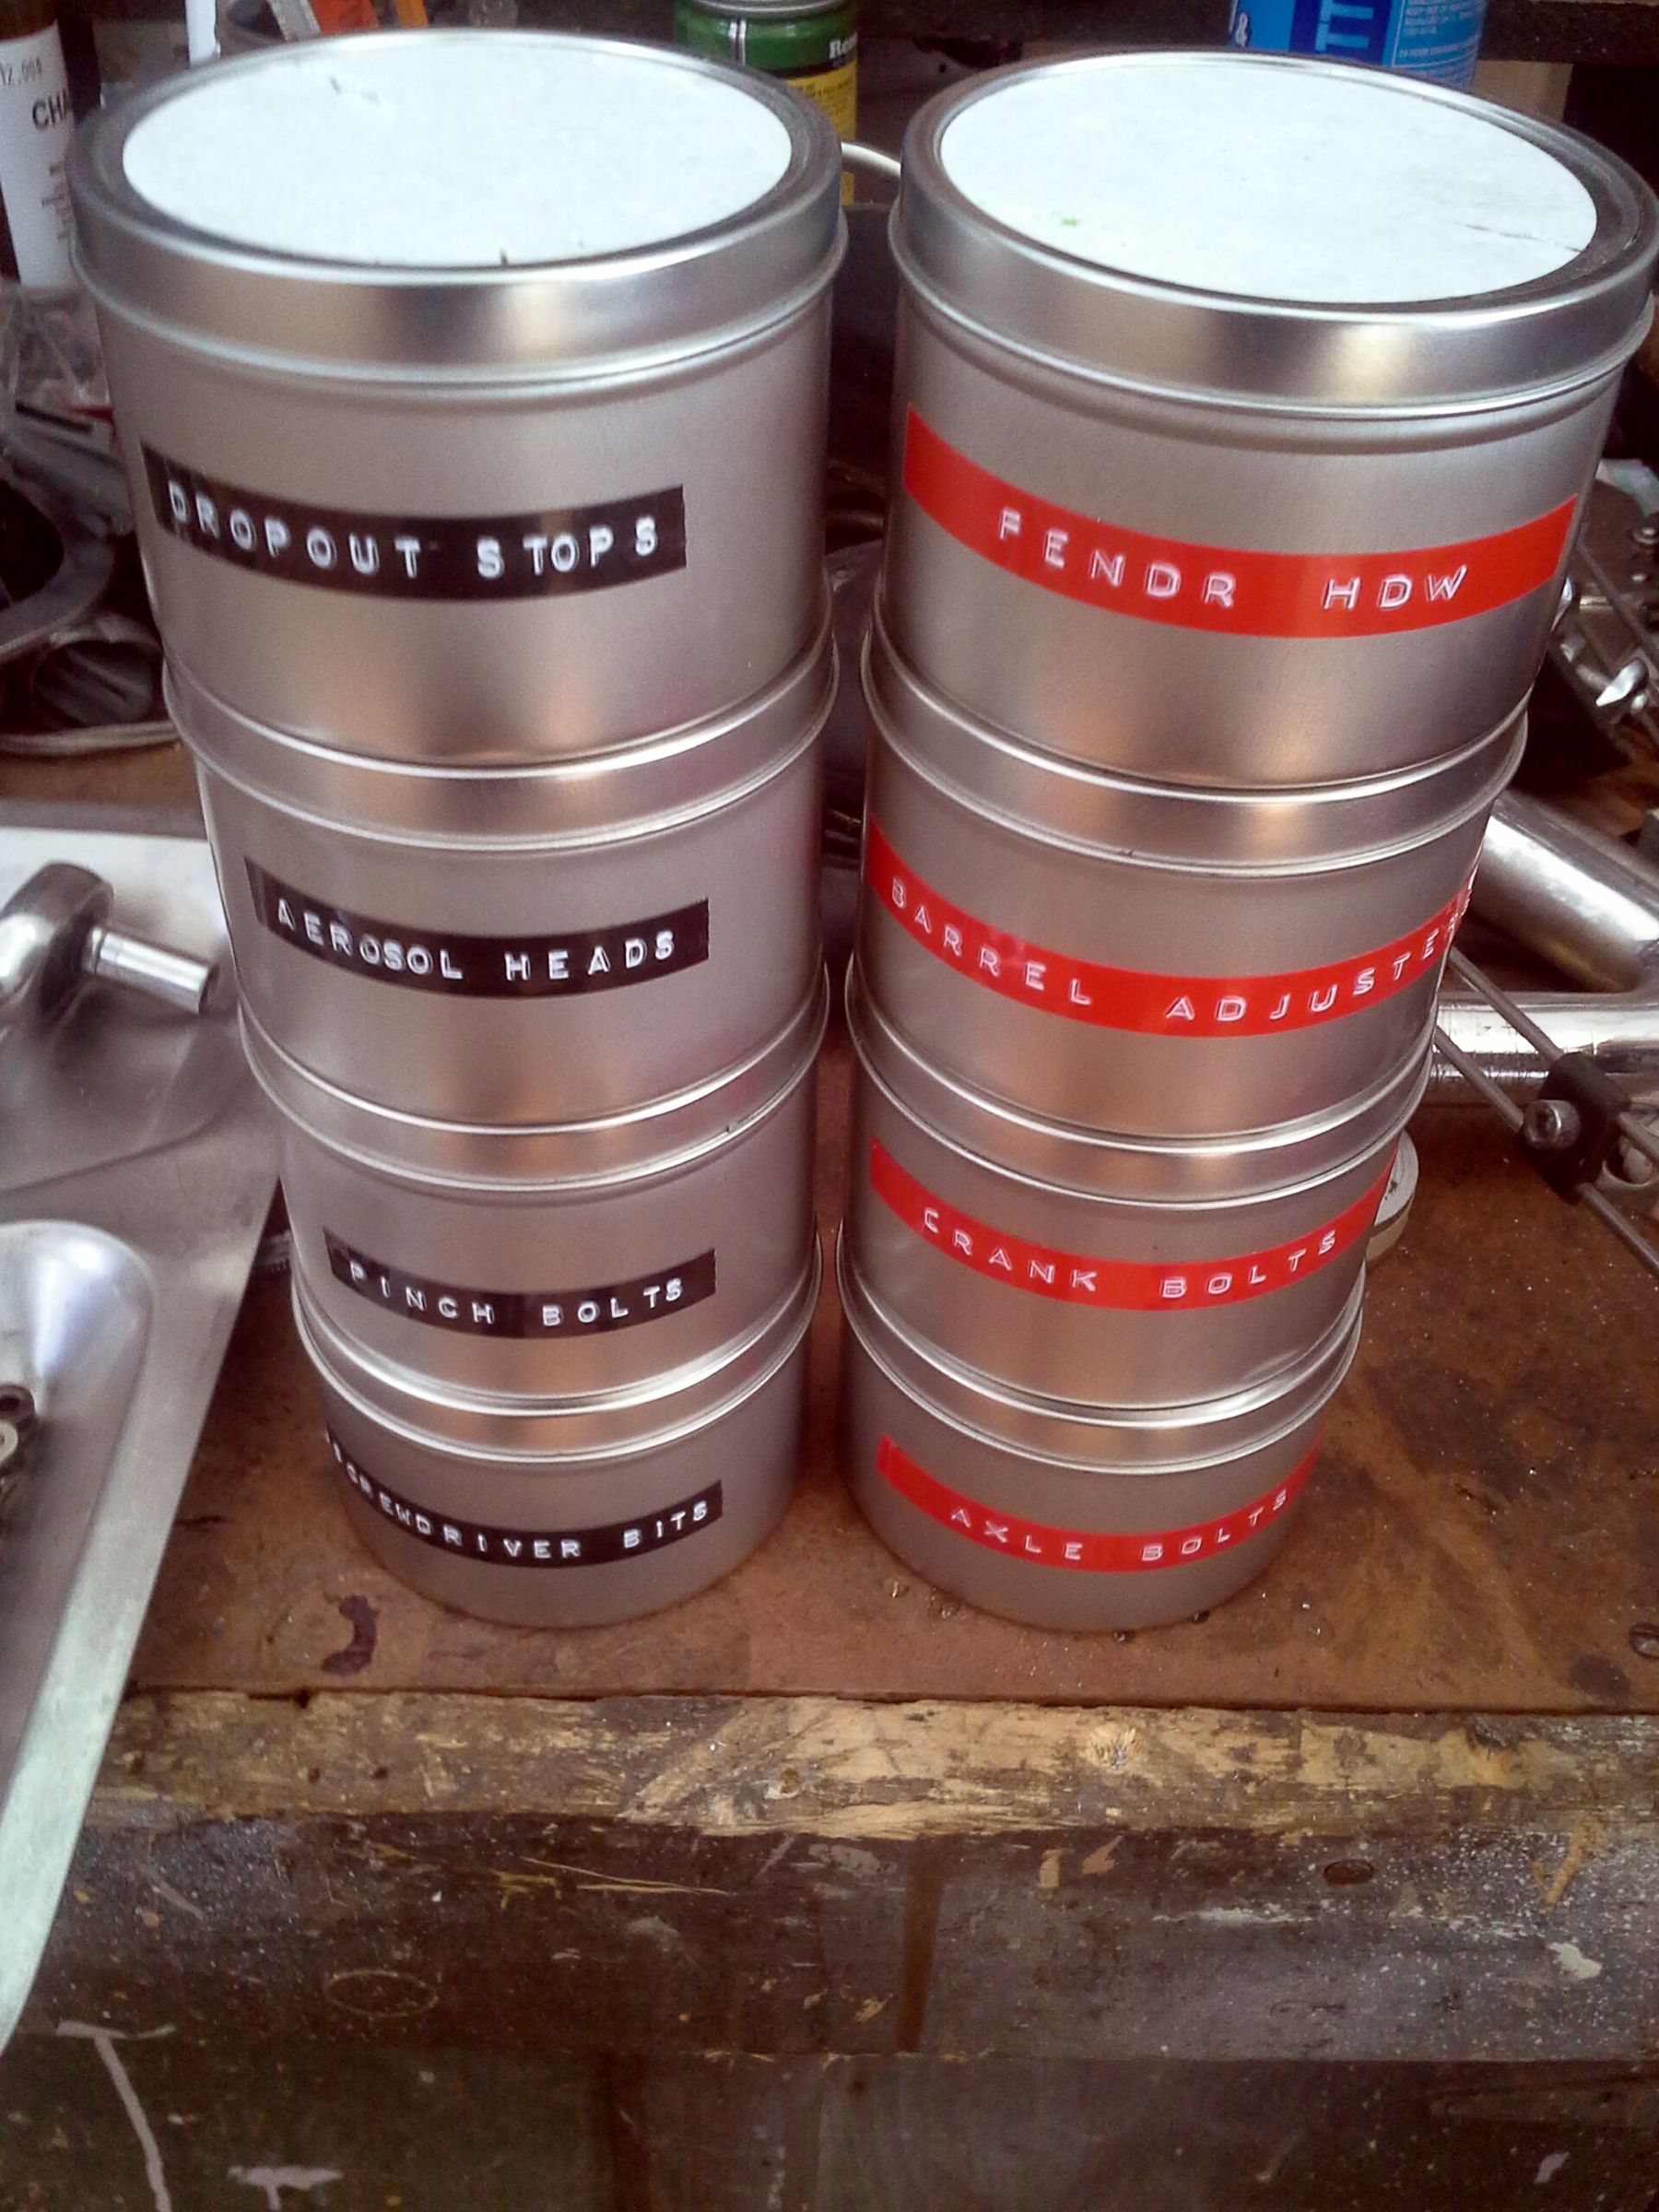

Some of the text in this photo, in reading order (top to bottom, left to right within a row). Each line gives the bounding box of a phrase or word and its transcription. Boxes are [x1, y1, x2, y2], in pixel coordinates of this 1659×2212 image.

[168, 478, 658, 580] DROPOUT STOPS
[998, 507, 1468, 610] FENDR HDW
[278, 898, 676, 982] AEROSOL HEADS
[891, 877, 1092, 1006] BARREL
[348, 1259, 683, 1327] PINCH BOLTS
[923, 1206, 1336, 1299] CRANK BOLTS
[622, 1500, 709, 1549] BITS
[949, 1488, 1288, 1562] AXLE BOLTS
